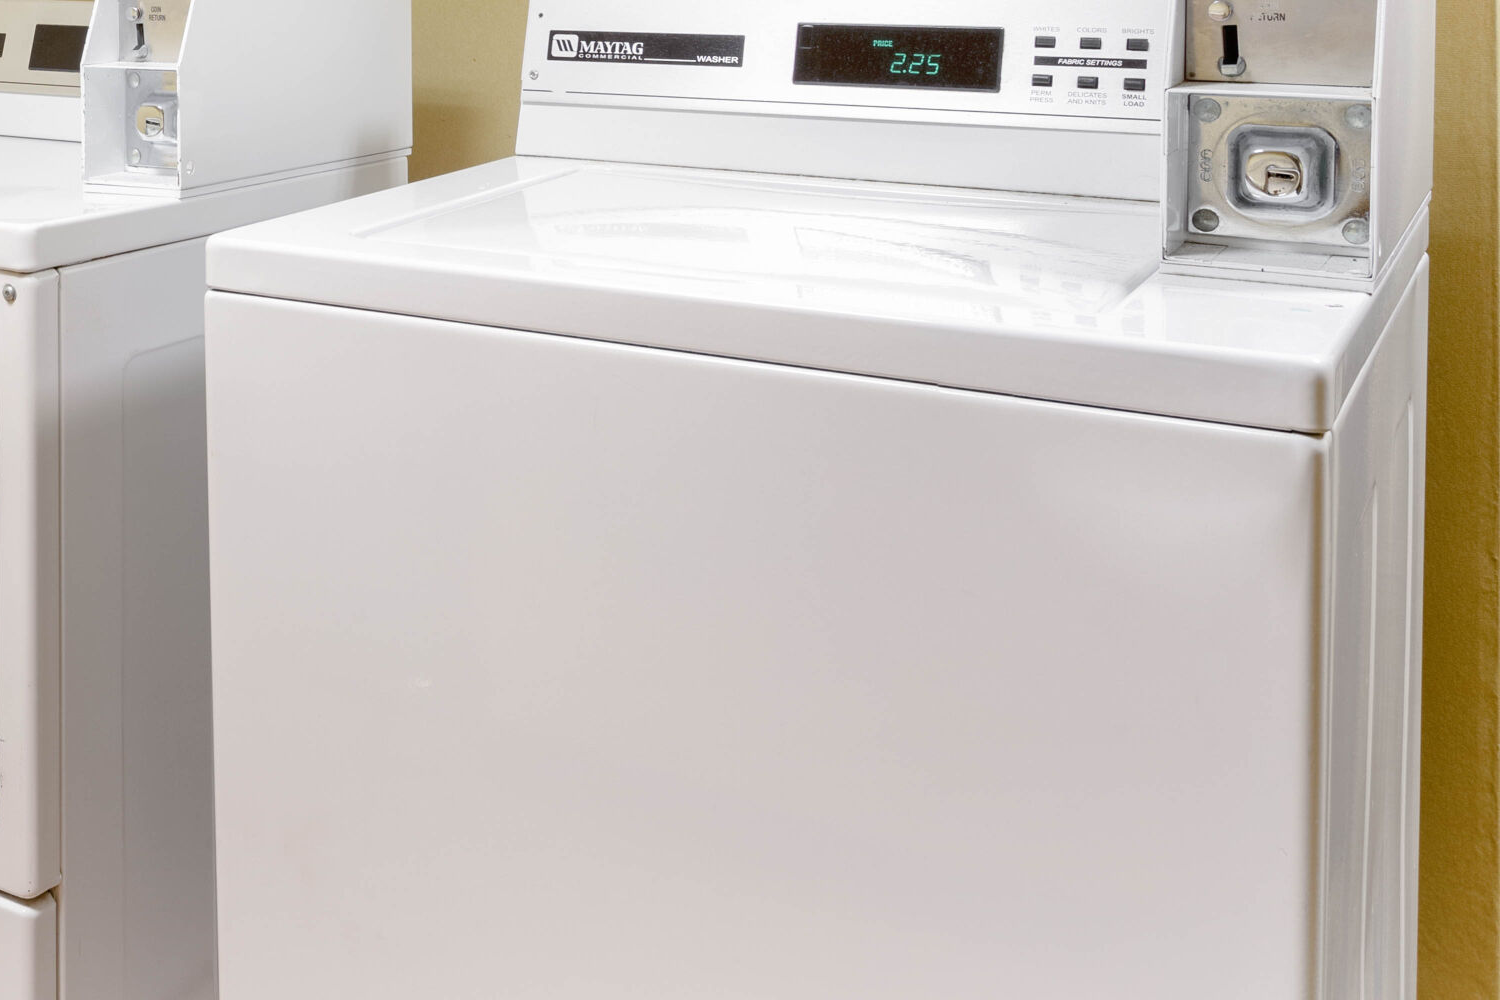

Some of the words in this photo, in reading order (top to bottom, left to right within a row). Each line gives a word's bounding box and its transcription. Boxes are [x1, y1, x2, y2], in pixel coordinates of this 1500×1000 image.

[1076, 26, 1108, 34] COLORS
[579, 40, 644, 55] MAYTAG
[872, 39, 894, 48] PRICE
[578, 53, 643, 61] COMMERCIAL
[696, 55, 739, 64] WASHER
[889, 52, 942, 75] 2.25
[1057, 58, 1085, 66] FABRIC
[1085, 59, 1123, 67] SETTINGS
[1067, 91, 1108, 99] DELICATES
[1121, 93, 1147, 101] SMALL
